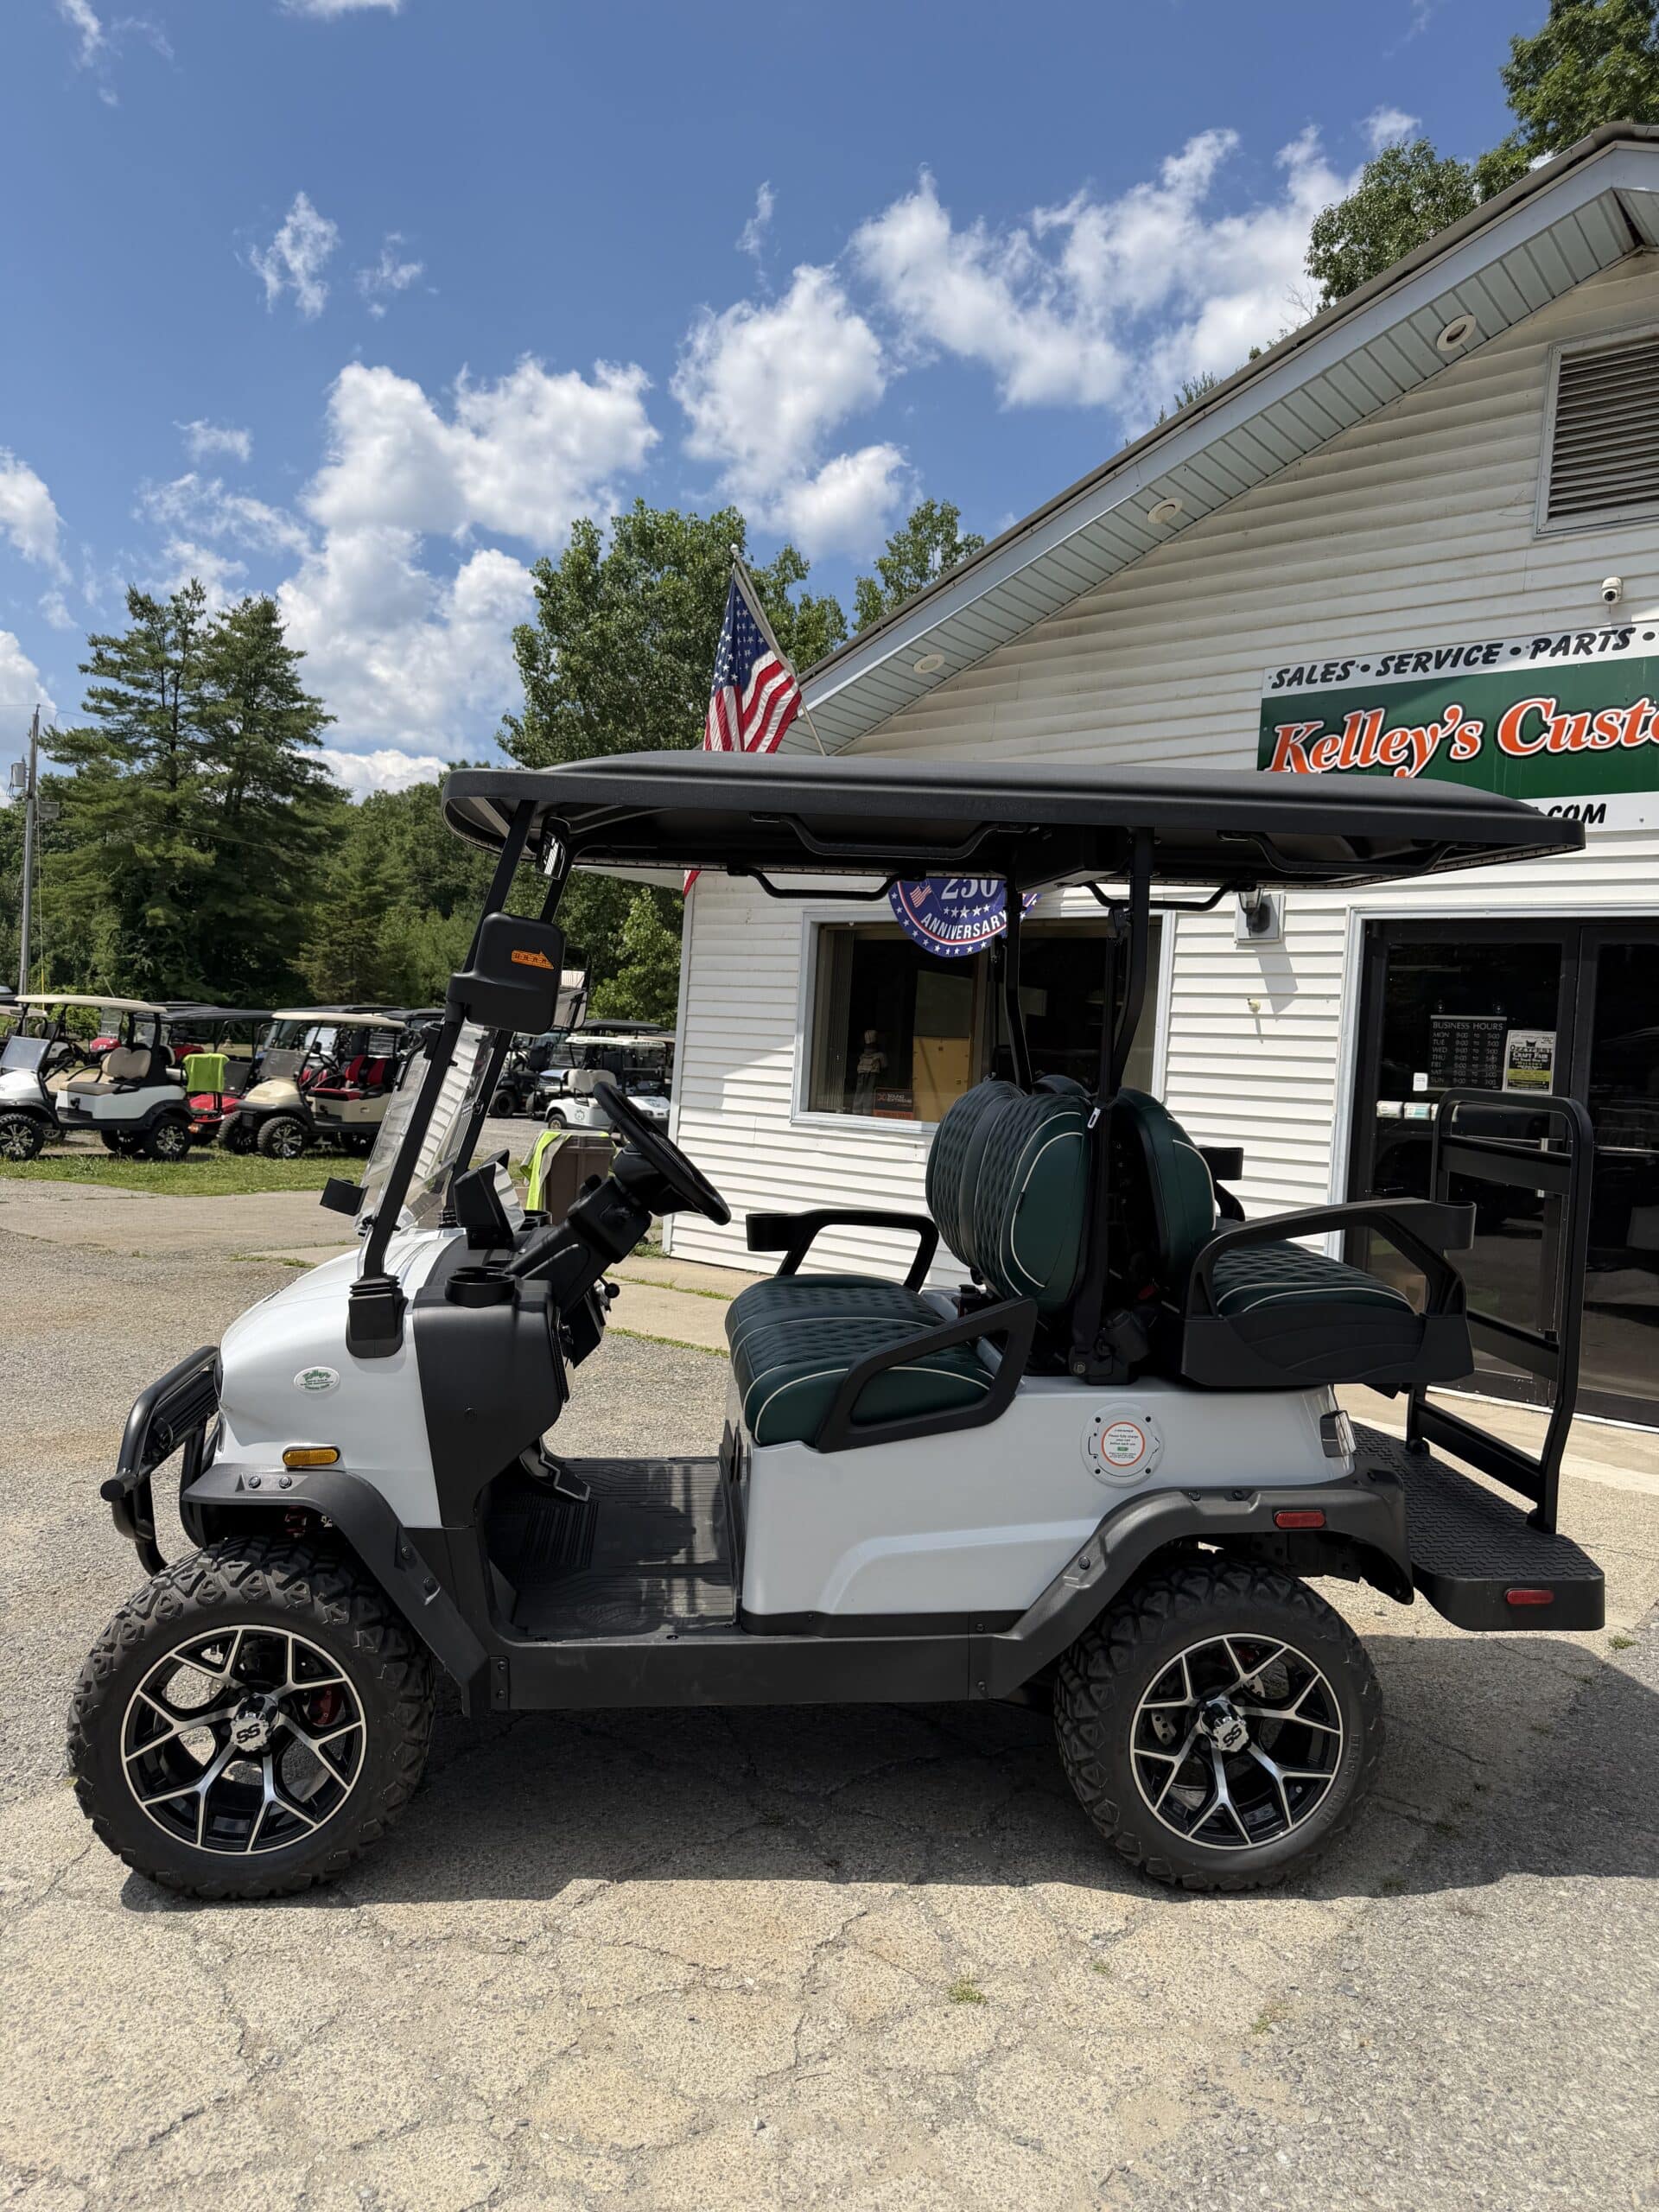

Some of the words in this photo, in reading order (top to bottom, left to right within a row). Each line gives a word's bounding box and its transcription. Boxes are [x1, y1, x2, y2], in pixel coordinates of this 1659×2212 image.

[1271, 660, 1356, 689] SALES
[1375, 643, 1503, 677] SERVICE
[1529, 627, 1637, 659] PARTS
[1265, 704, 1483, 778] Kelley's
[941, 880, 999, 899] 250
[921, 911, 1007, 940] ANNIVERSARY
[1433, 1021, 1470, 1030] BUSINESS
[236, 1722, 261, 1744] SS
[1223, 1724, 1242, 1747] SS
